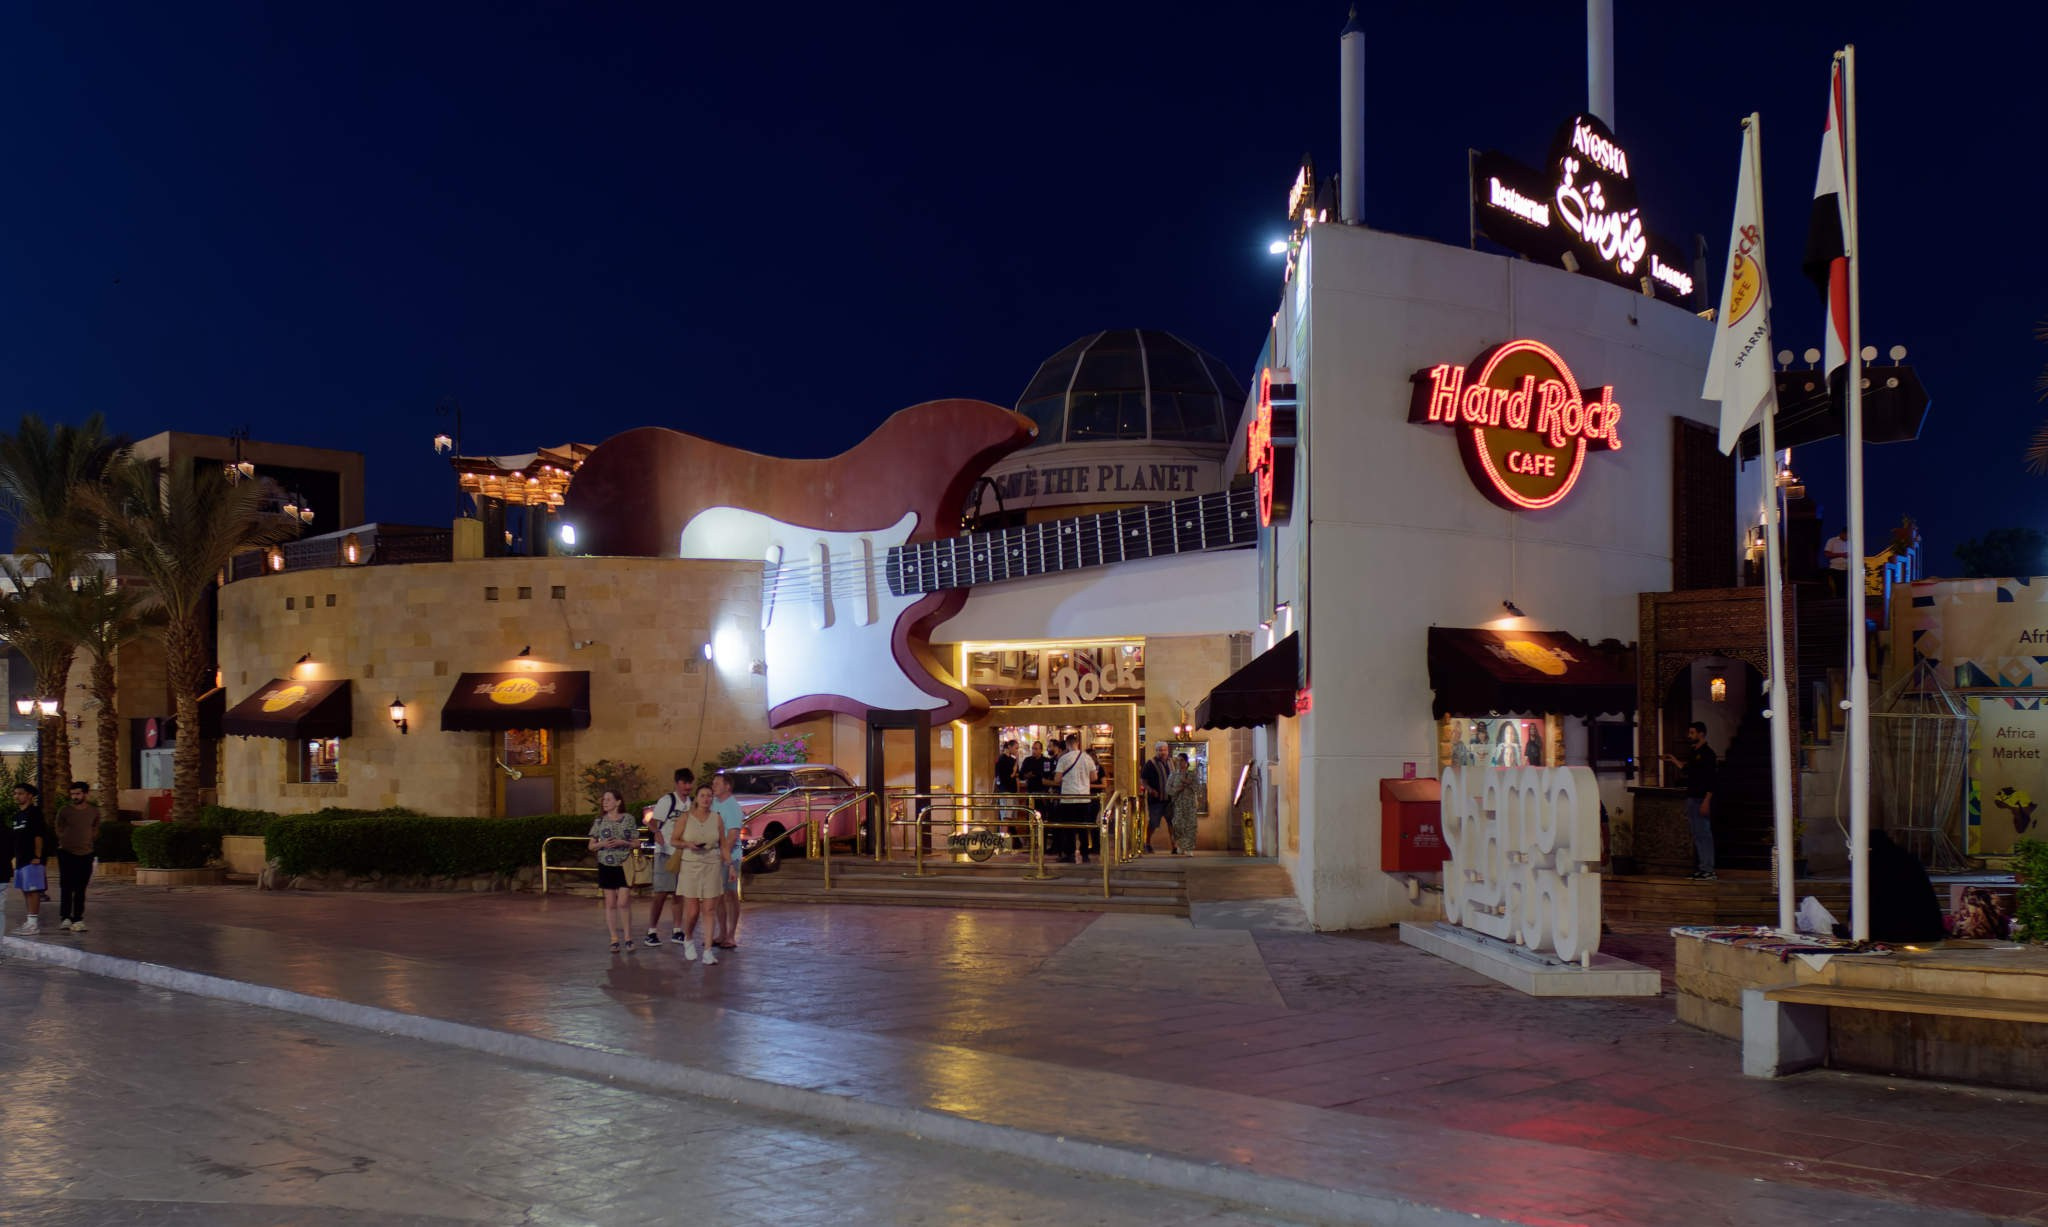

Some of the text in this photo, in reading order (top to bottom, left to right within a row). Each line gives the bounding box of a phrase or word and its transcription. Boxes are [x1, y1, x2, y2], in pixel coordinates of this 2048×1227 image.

[1490, 177, 1550, 228] Restaurant
[1651, 254, 1693, 296] Lounge
[1734, 325, 1767, 369] SHARM
[1428, 364, 1622, 450] Hard Rock
[1041, 466, 1089, 494] THE
[1097, 464, 1198, 492] PLANET
[1508, 451, 1555, 476] CAFE
[1053, 647, 1142, 705] Rock
[1996, 727, 2036, 739] Africa
[1992, 748, 2041, 759] Market
[952, 834, 1004, 848] Hard Rock
